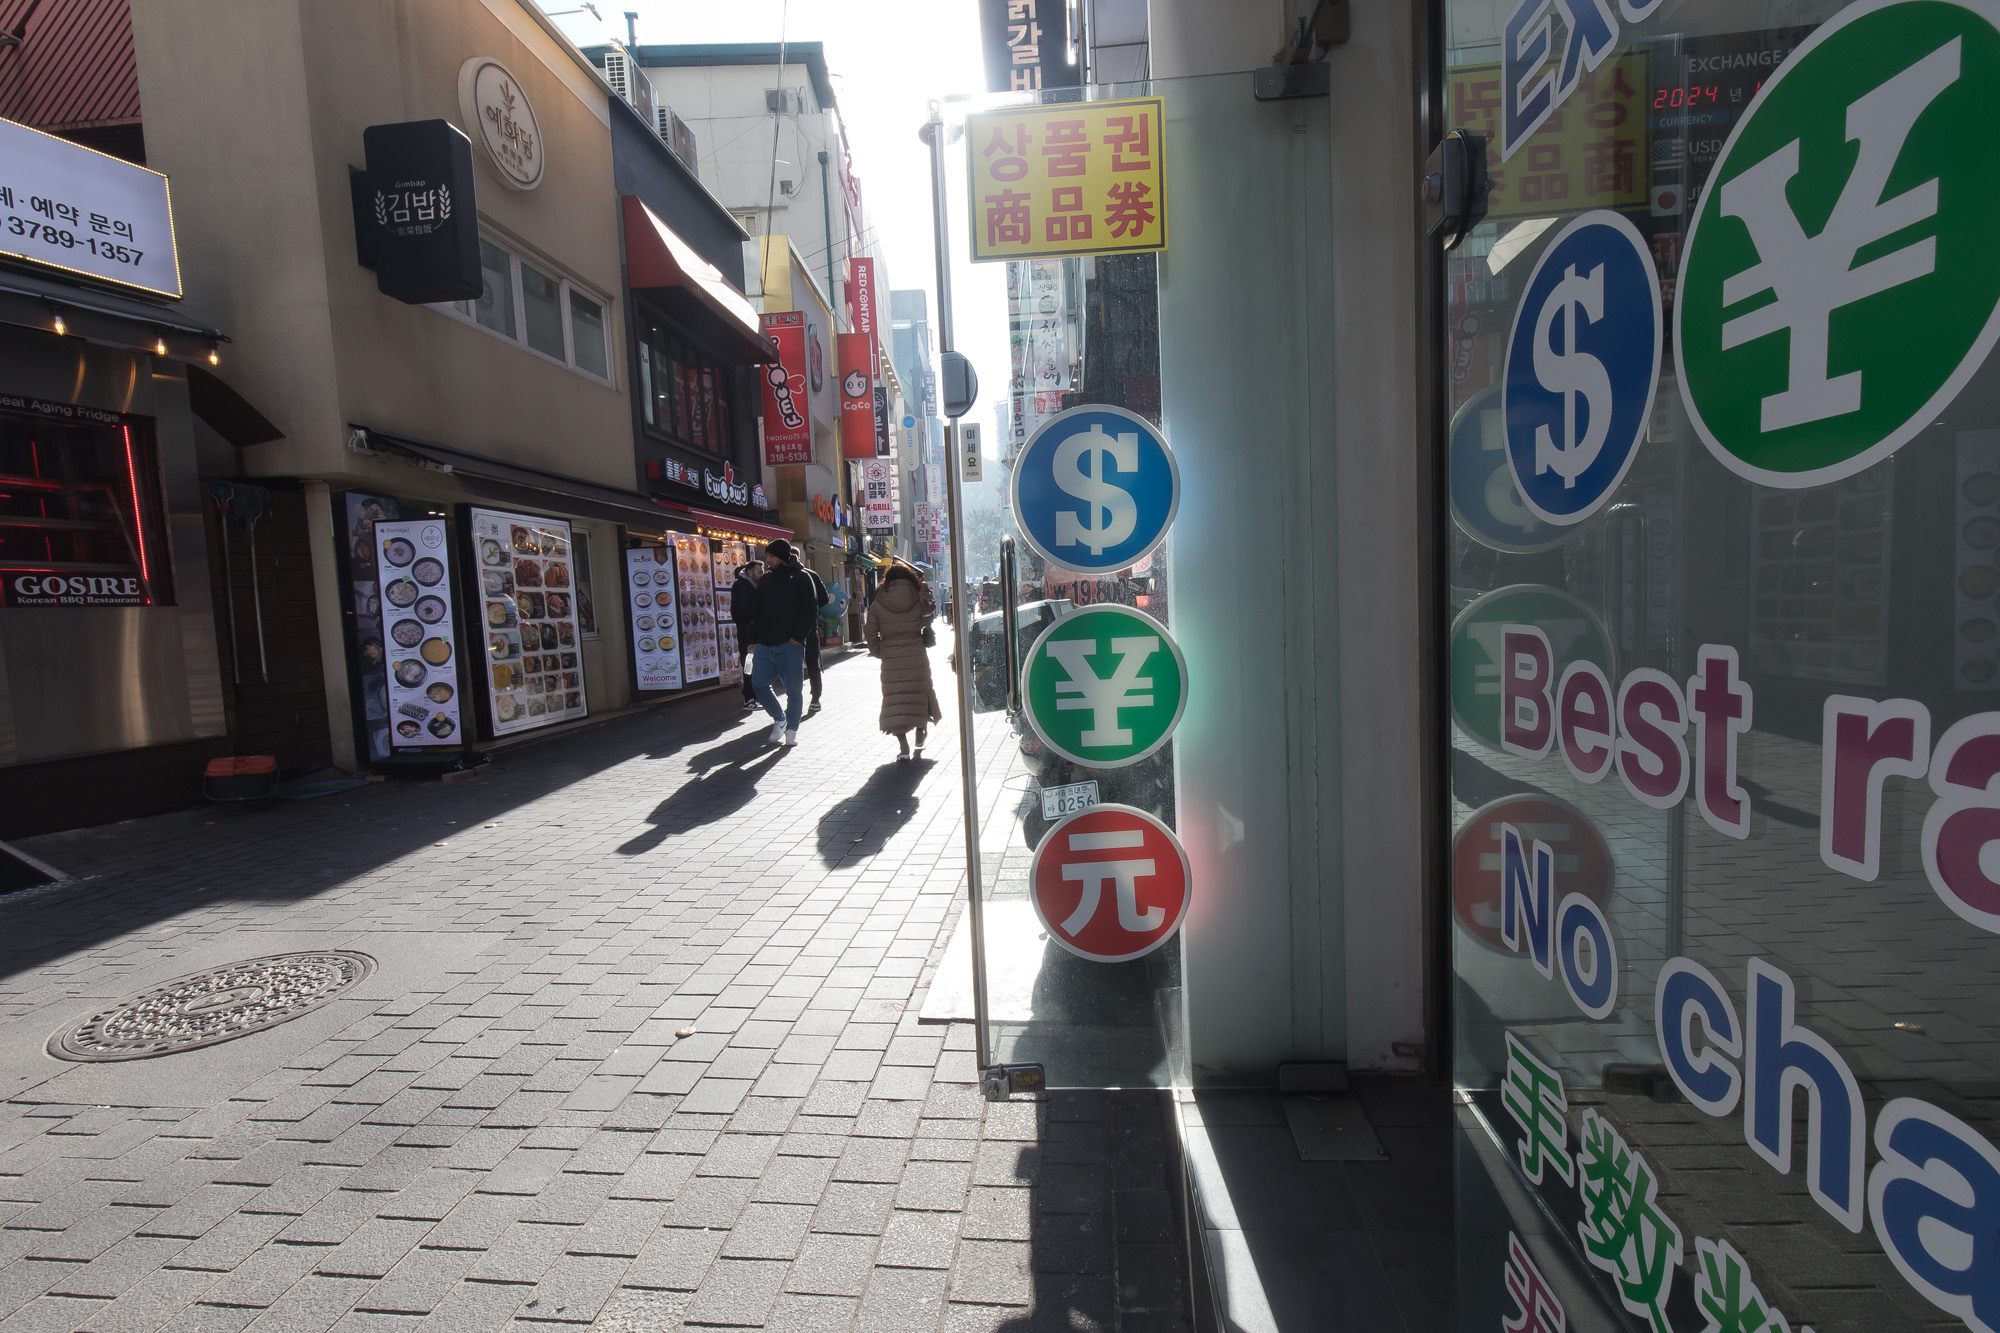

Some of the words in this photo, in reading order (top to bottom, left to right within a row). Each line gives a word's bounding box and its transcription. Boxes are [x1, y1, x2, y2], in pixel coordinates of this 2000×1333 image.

[1688, 51, 1782, 73] EXCHANGE
[1654, 85, 1718, 109] 2024
[486, 105, 534, 160] 예화당
[1659, 114, 1714, 127] CURRENCY
[982, 113, 1151, 182] 상품권
[1688, 139, 1723, 155] USD
[395, 180, 426, 188] Gimbap
[388, 189, 437, 222] 김밥
[984, 181, 1156, 247] 商品券
[89, 211, 134, 243] 문의
[8, 215, 144, 266] 3789-1357
[857, 265, 868, 287] RED
[0, 396, 26, 410] eat
[31, 400, 73, 417] Aging
[77, 406, 120, 423] Fridge
[843, 402, 871, 412] CoCo
[769, 452, 808, 463] 318-5136
[966, 429, 977, 467] 미세요
[868, 481, 886, 490] 대한
[1052, 424, 1139, 555] $
[15, 576, 140, 595] GOSIRE
[17, 596, 57, 604] Korean
[60, 596, 84, 605] BBQ
[87, 596, 141, 604] Restaurant
[642, 674, 677, 682] Welcome
[1046, 635, 1160, 747] ¥
[1503, 626, 1749, 836] Best
[1058, 794, 1095, 813] 0256
[1060, 829, 1166, 938] 元
[1503, 825, 1616, 1018] No
